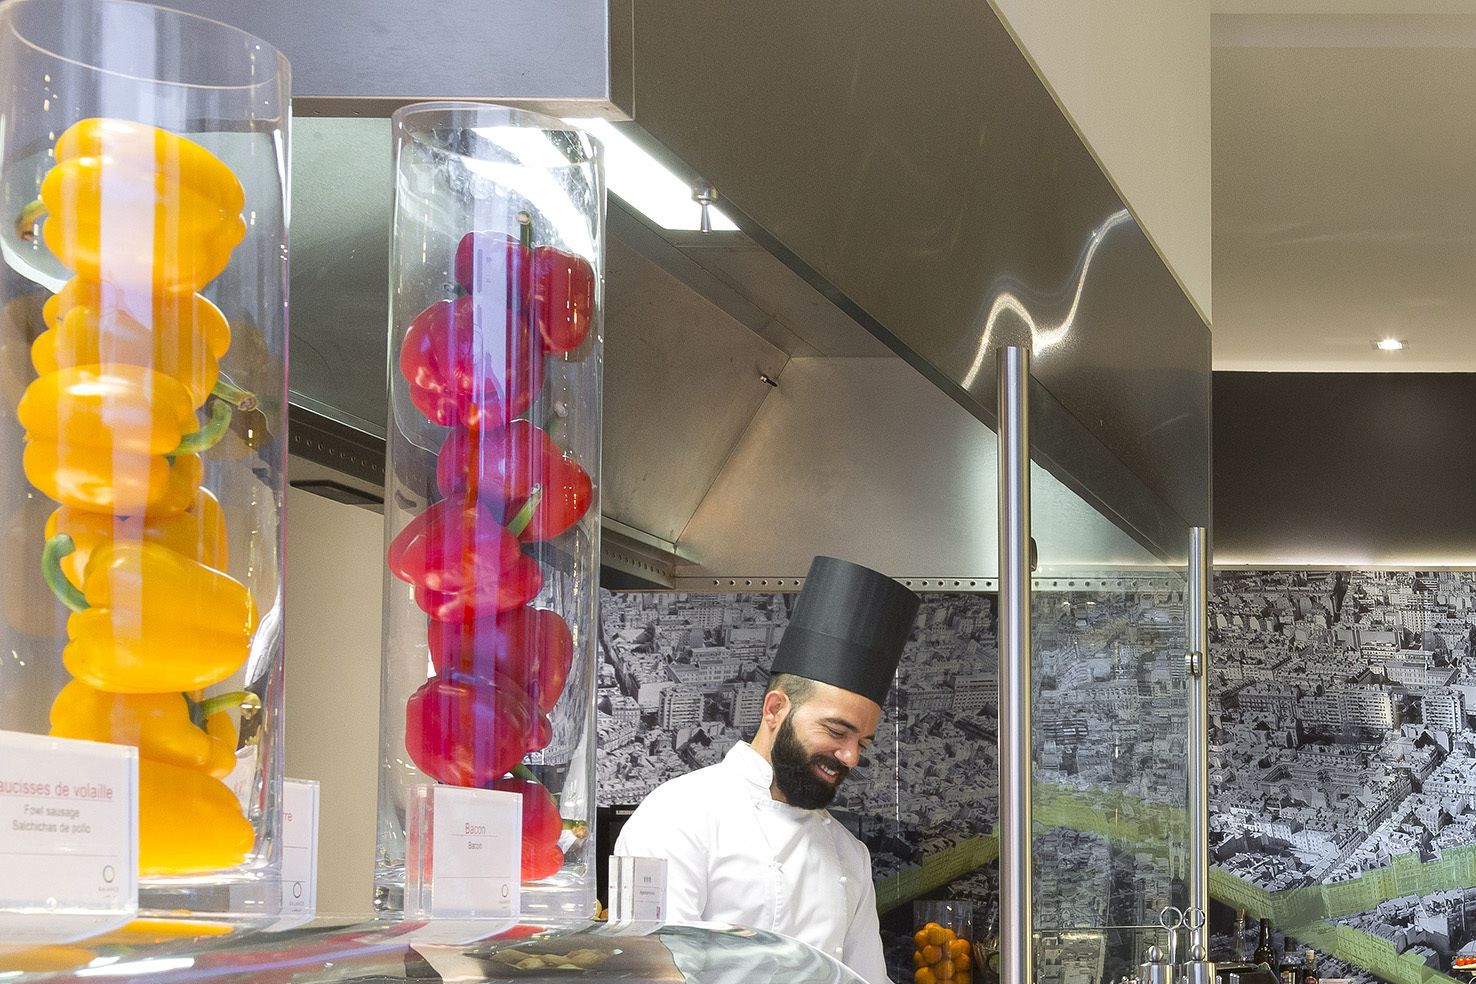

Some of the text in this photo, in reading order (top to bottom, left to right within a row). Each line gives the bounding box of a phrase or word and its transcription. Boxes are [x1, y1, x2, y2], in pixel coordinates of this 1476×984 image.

[54, 781, 70, 797] de
[74, 783, 113, 800] volaille
[24, 804, 80, 820] Fowl sausage
[59, 823, 70, 833] de
[465, 822, 486, 835] Bacon
